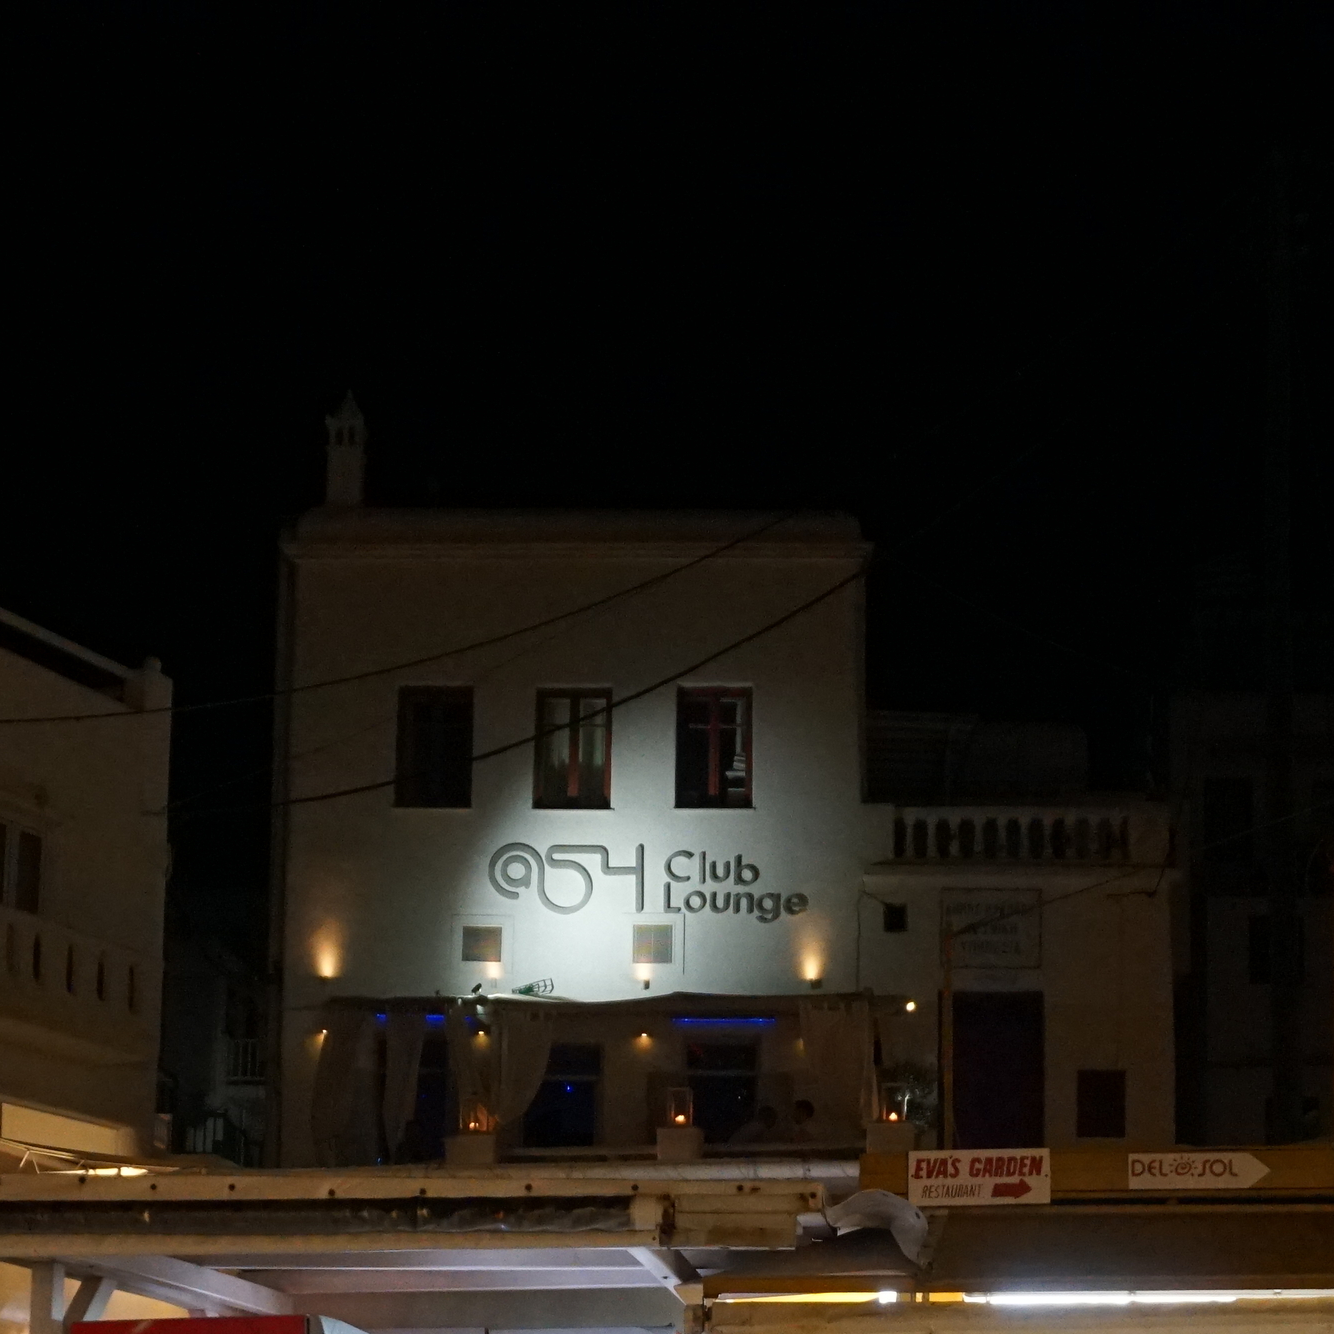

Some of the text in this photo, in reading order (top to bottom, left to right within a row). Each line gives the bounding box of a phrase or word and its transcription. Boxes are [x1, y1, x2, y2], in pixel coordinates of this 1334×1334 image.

[663, 850, 760, 886] Club
[663, 881, 810, 924] Lounge
[913, 1155, 1044, 1179] EVA'S GARDEN
[1131, 1158, 1239, 1178] DEL SOL
